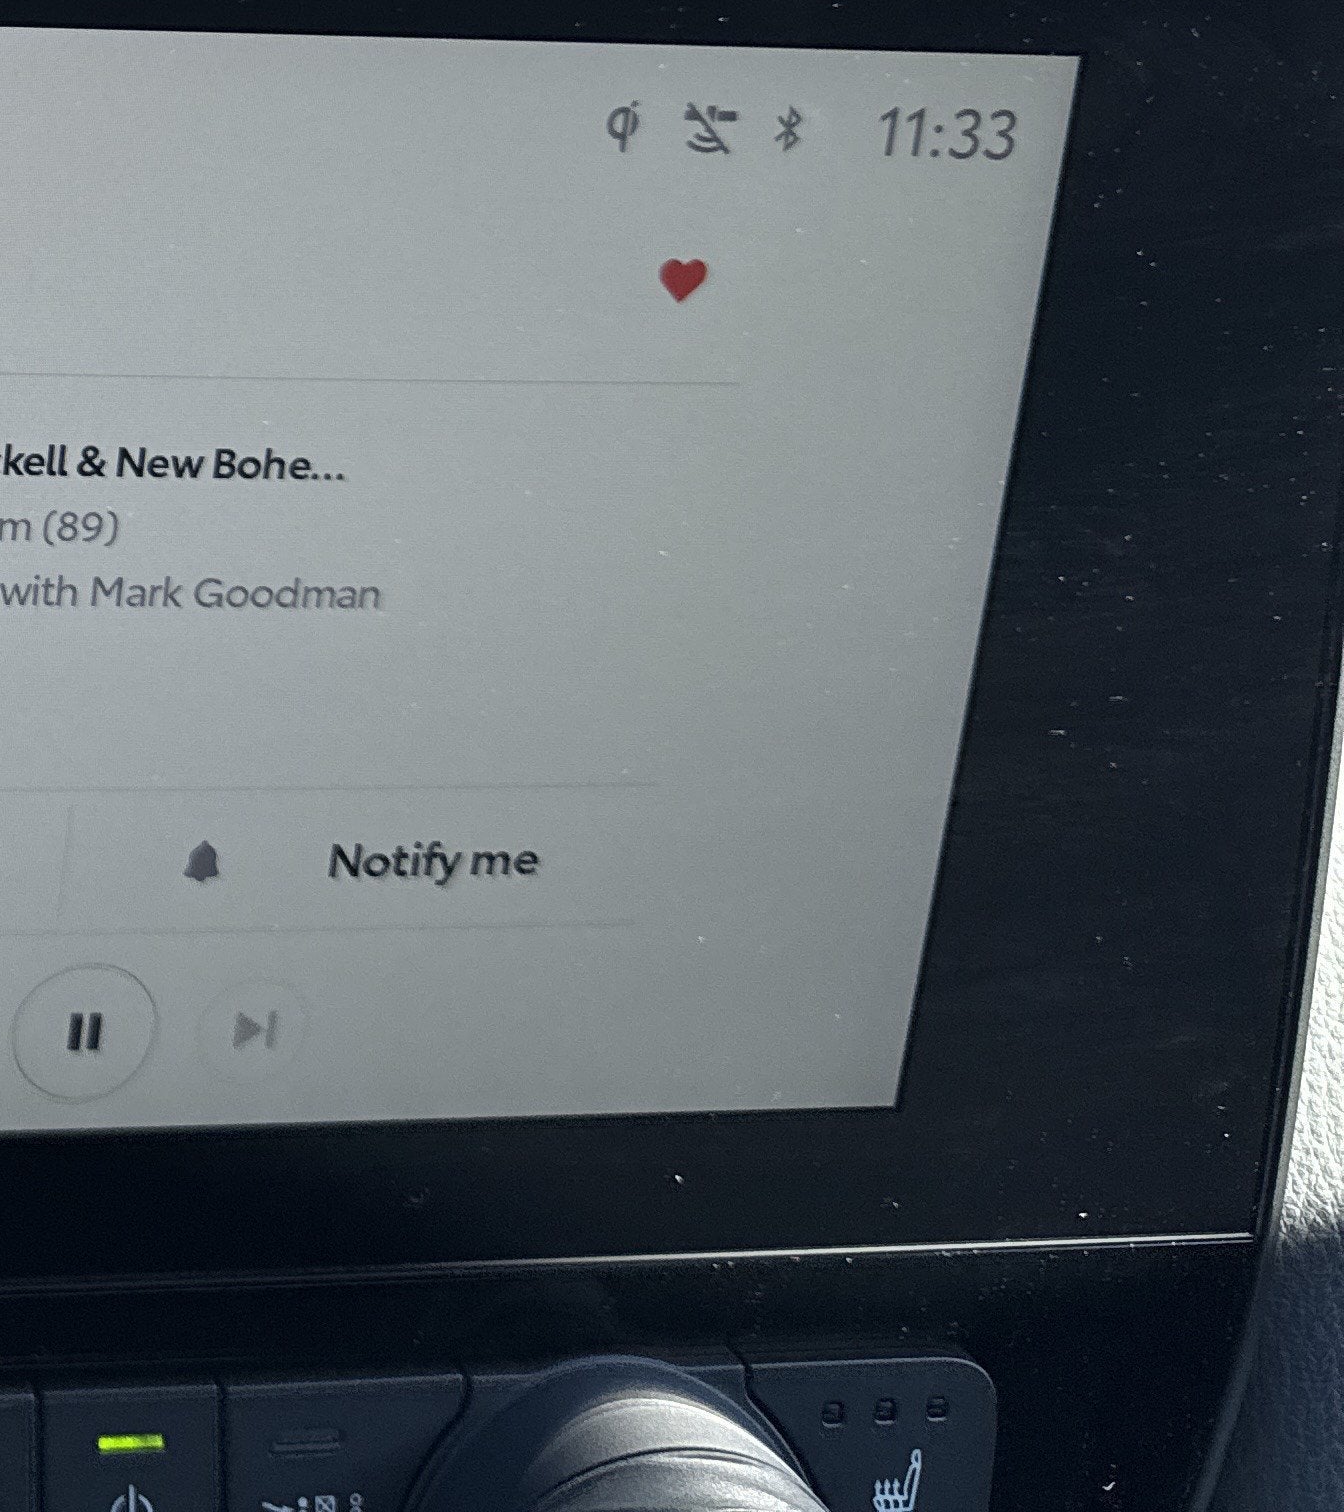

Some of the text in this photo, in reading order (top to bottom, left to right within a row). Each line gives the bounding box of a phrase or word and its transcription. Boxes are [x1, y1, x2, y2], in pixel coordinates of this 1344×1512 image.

[880, 108, 1018, 161] 11:33
[77, 445, 107, 478] &
[116, 447, 205, 480] New
[213, 448, 347, 482] Bohe...
[42, 509, 120, 548] (89)
[0, 574, 79, 608] with
[90, 576, 183, 609] Mark
[193, 578, 382, 611] Goodman
[328, 841, 540, 886] Notify me
